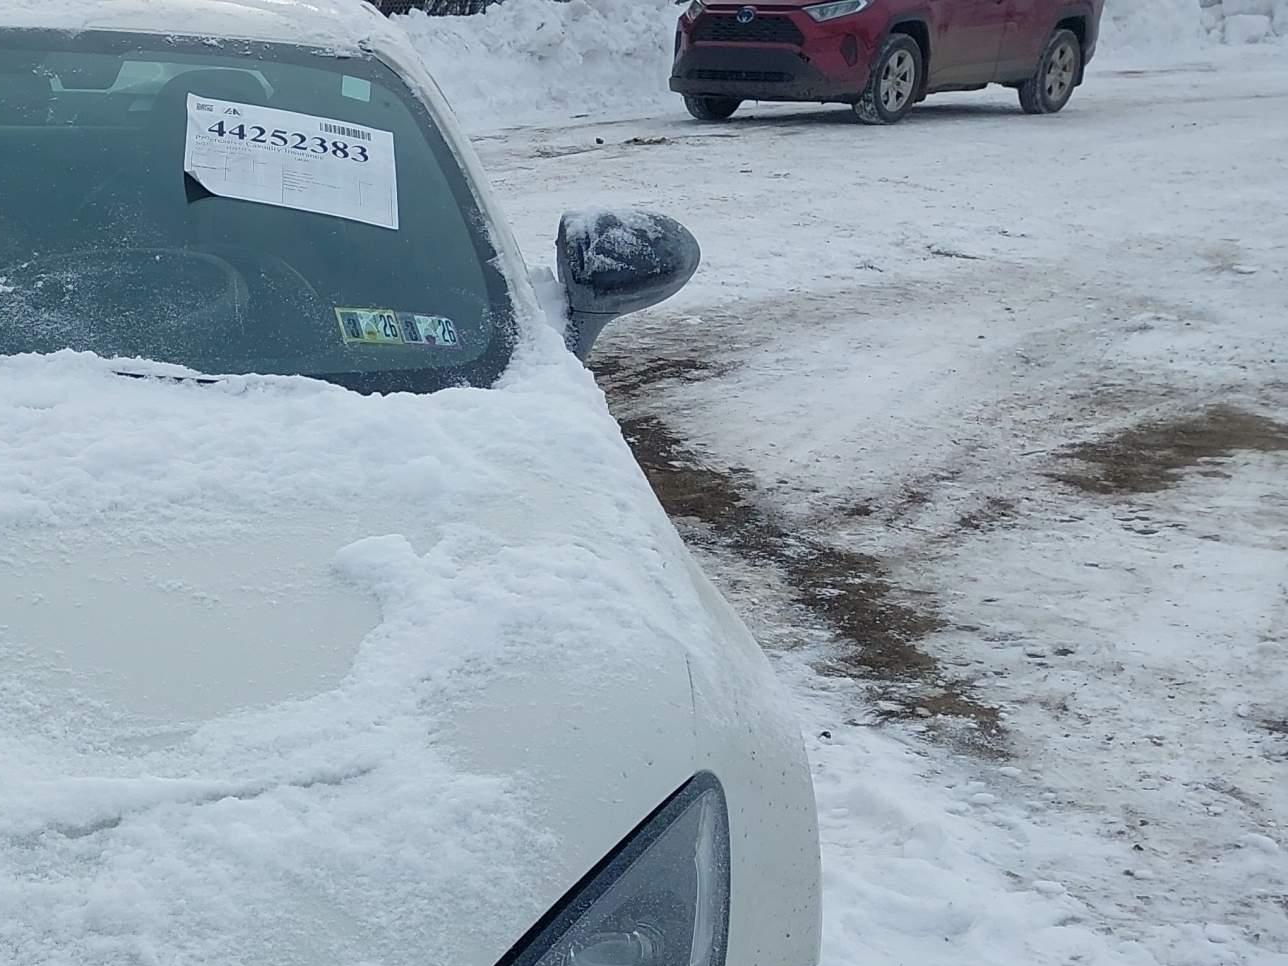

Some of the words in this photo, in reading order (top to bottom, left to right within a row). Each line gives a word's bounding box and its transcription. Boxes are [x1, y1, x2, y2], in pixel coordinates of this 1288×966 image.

[208, 120, 369, 163] 44252383
[347, 318, 360, 338] 3
[379, 314, 398, 338] 26
[405, 320, 418, 342] 3
[438, 320, 457, 343] 26
